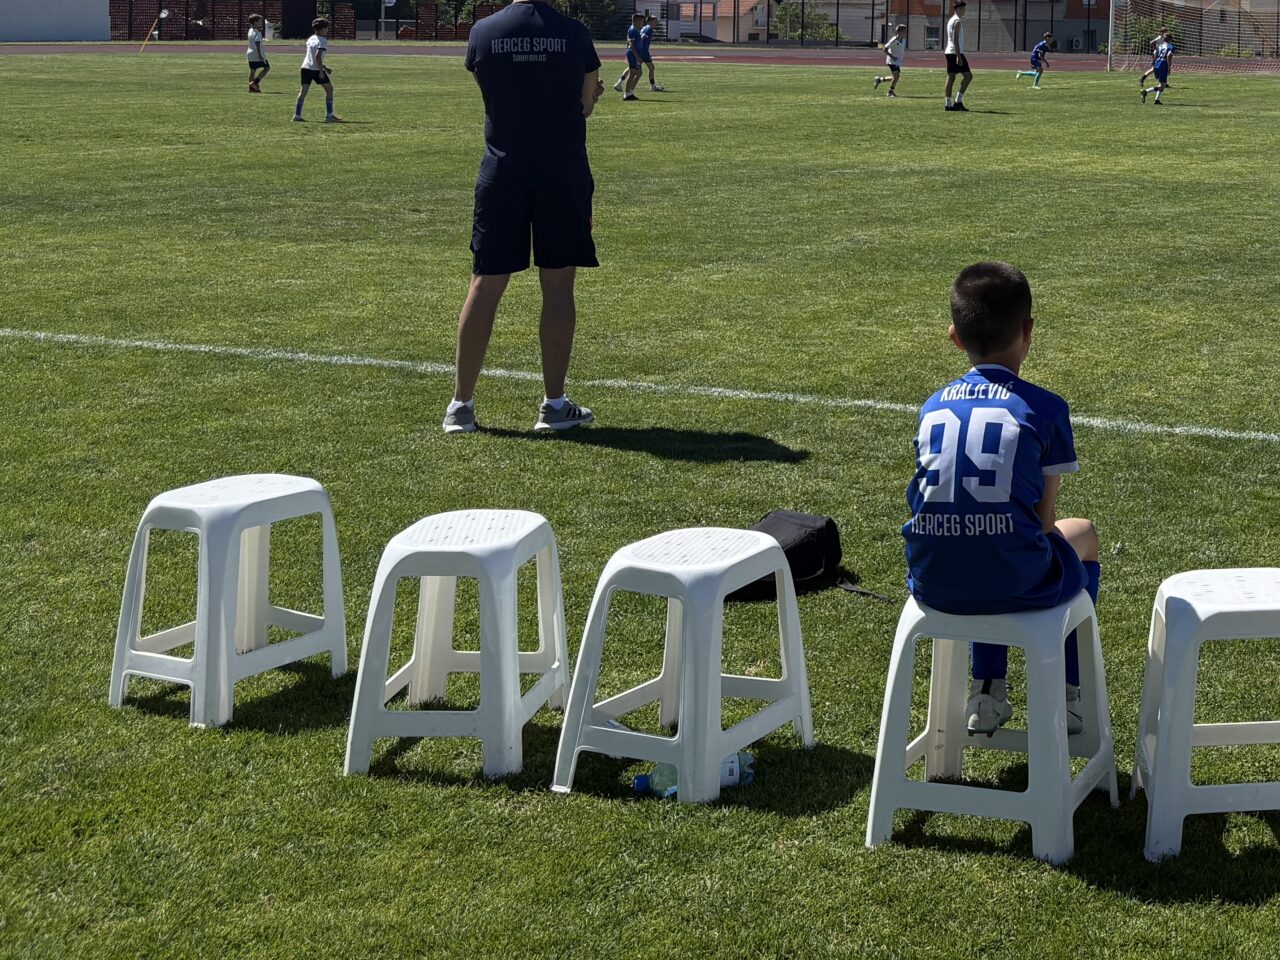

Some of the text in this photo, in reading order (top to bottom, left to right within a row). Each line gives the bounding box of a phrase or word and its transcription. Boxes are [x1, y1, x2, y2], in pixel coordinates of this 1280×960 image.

[491, 37, 567, 54] HERCEG SPORT
[940, 380, 1014, 402] KRALJEVIĆ
[918, 407, 1020, 503] 99
[911, 513, 1014, 536] HERCEG SPORT
